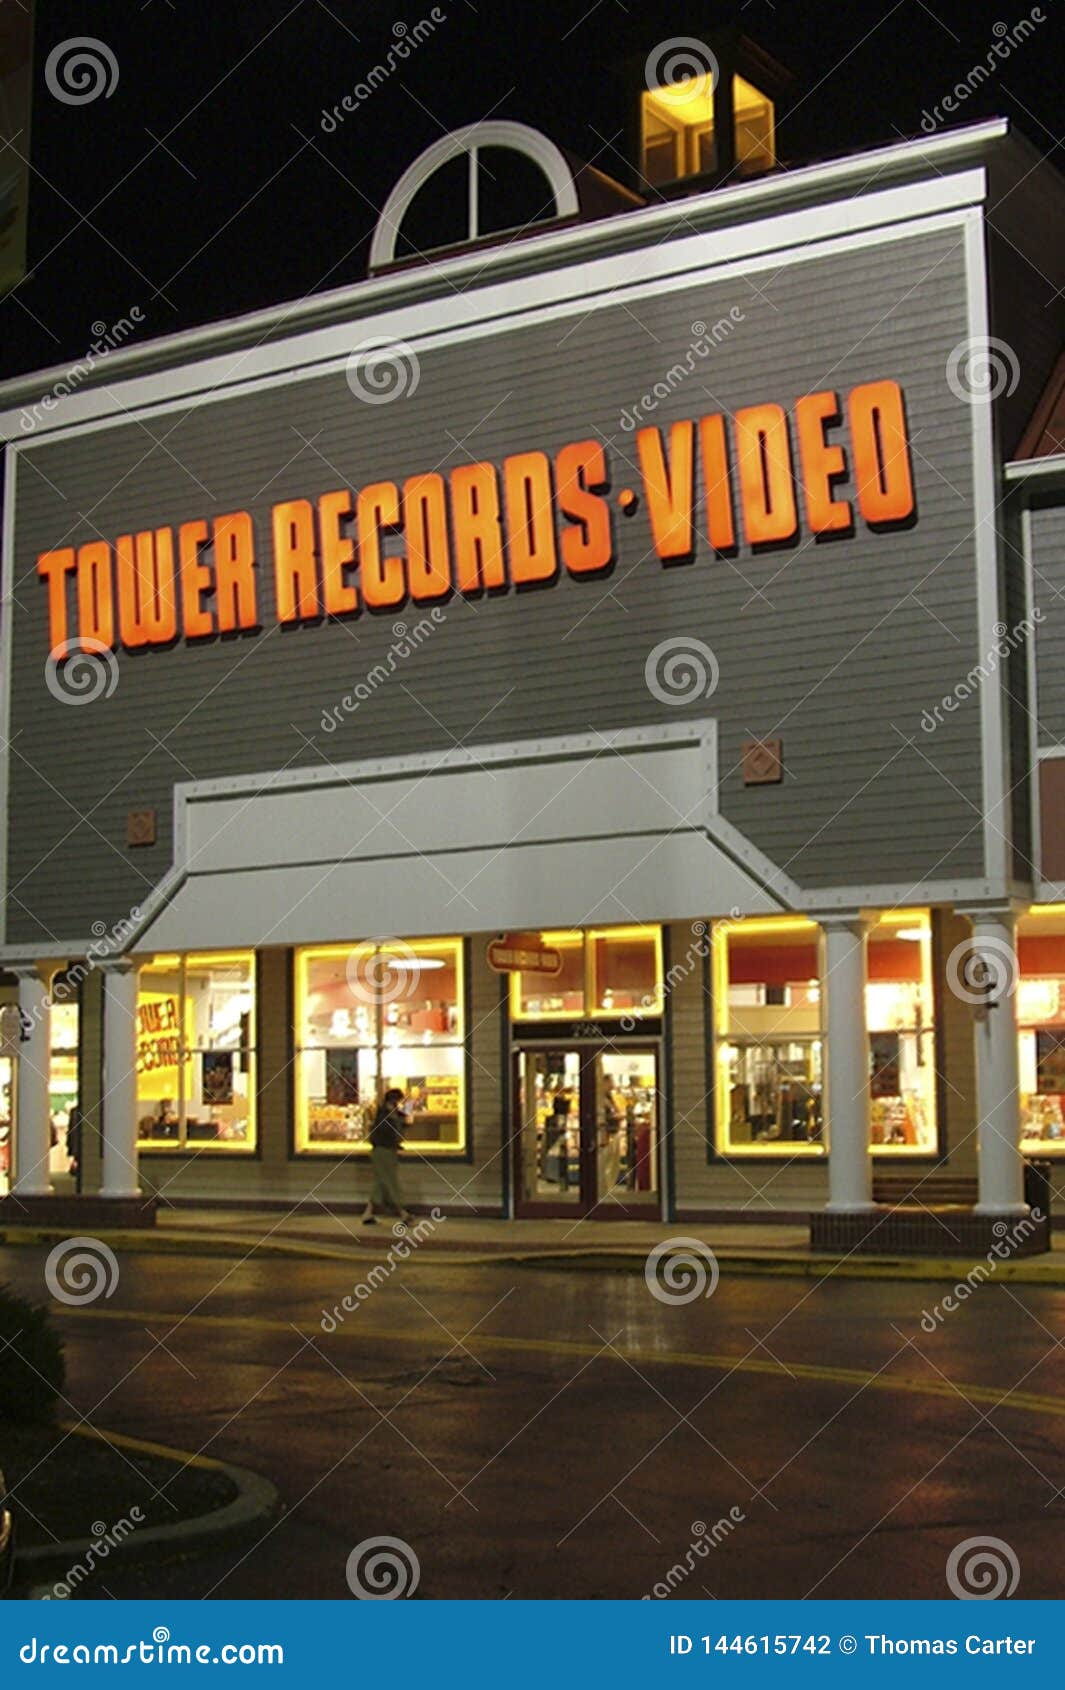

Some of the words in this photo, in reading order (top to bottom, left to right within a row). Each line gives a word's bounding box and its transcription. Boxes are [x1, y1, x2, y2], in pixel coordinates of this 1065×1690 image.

[38, 512, 257, 661] TOWER
[273, 441, 613, 622] RECORDS
[637, 380, 915, 560] VIDEO
